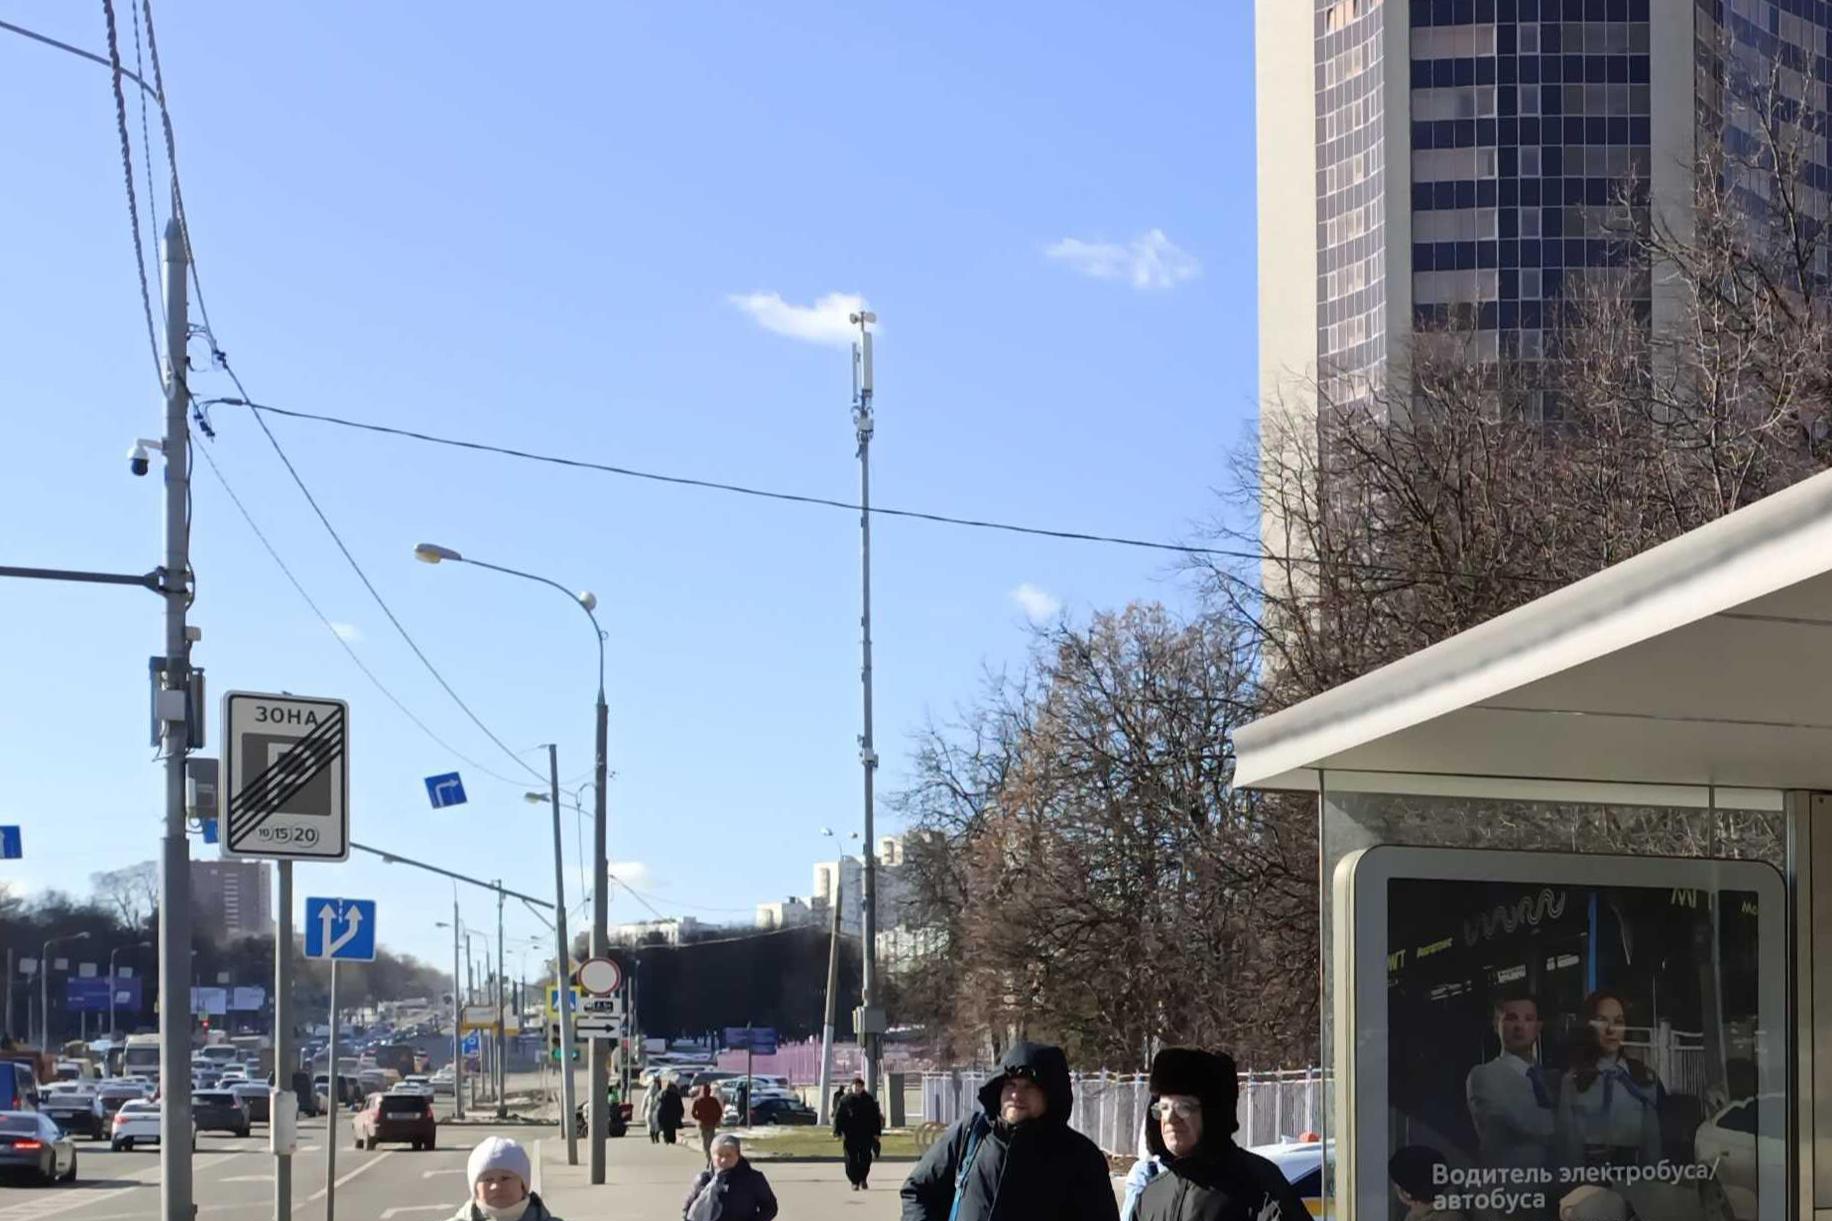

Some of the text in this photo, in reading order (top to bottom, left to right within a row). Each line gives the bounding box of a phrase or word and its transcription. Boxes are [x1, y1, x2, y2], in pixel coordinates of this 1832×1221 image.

[255, 706, 319, 726] ЗОНА
[259, 828, 316, 842] 10 15 20
[1432, 1157, 1720, 1188] Водитель электробуса/
[1433, 1188, 1546, 1214] автобуса
